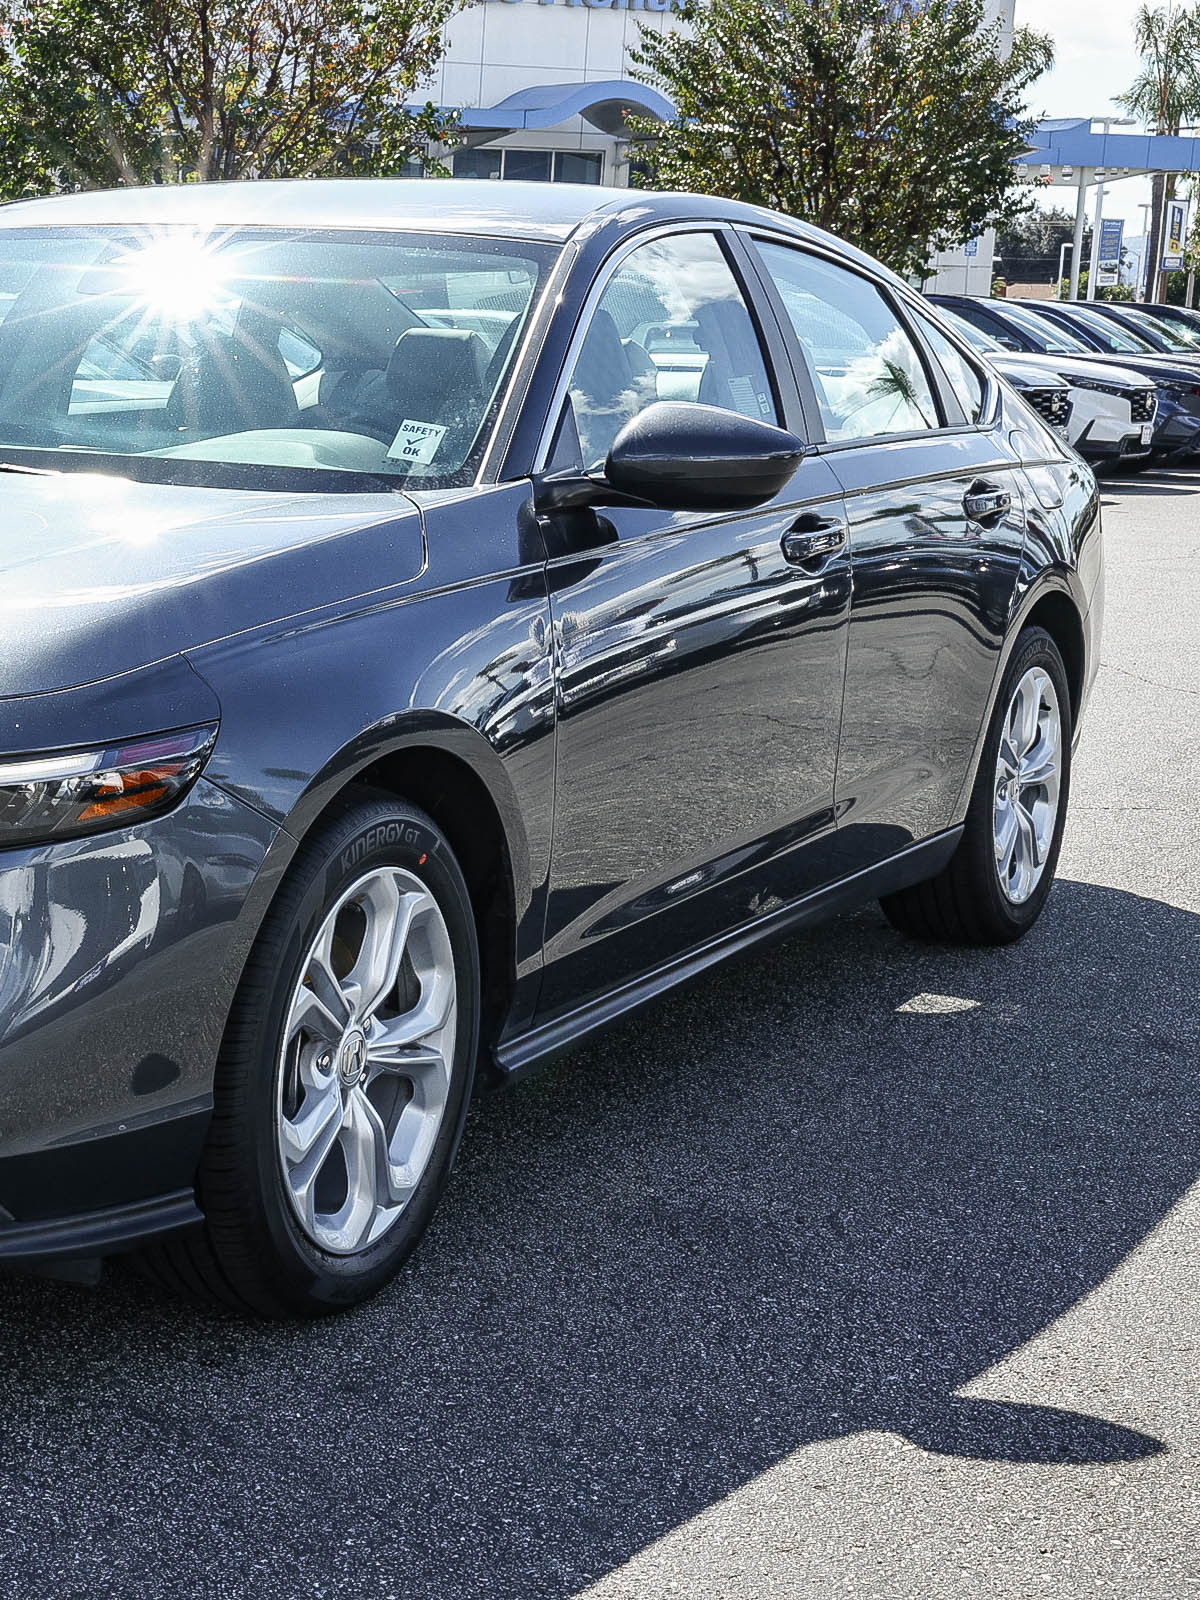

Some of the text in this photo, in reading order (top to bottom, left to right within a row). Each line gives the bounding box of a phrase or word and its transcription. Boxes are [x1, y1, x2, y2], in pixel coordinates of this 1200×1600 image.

[402, 424, 441, 437] SAFETY
[402, 446, 421, 456] OK
[405, 828, 420, 845] GT
